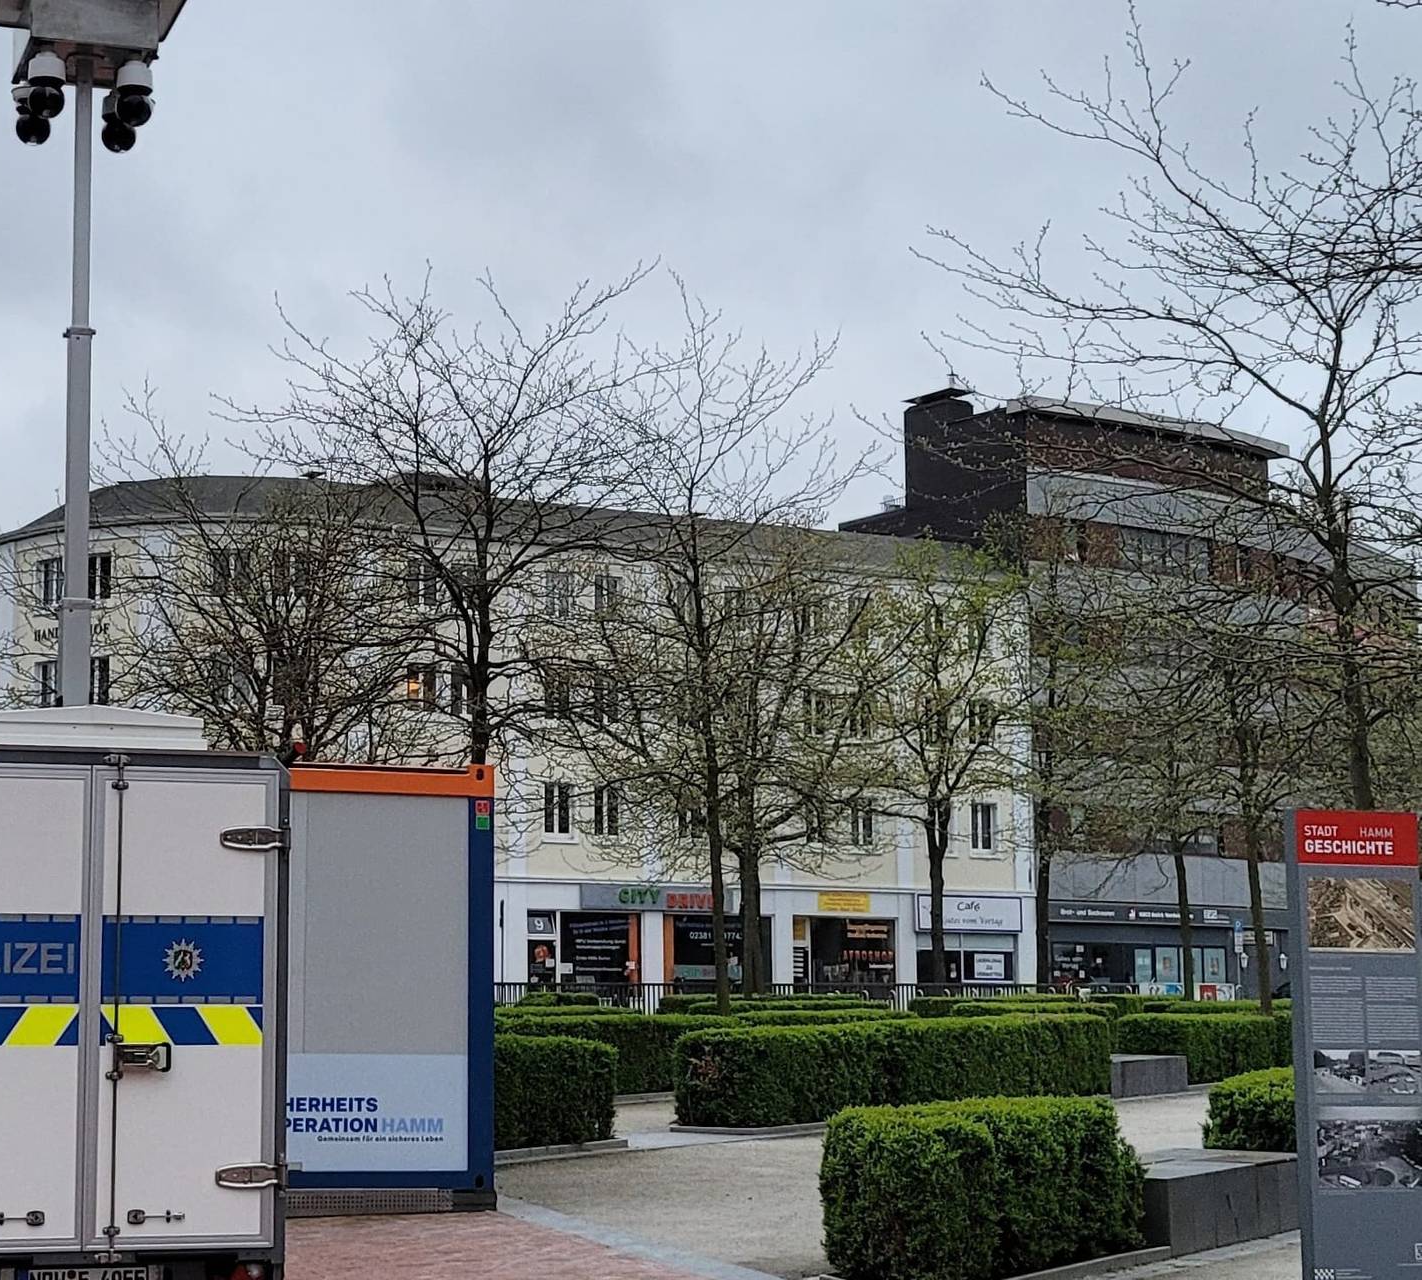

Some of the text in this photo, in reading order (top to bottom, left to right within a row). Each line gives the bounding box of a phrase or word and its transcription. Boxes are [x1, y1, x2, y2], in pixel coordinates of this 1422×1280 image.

[1304, 825, 1394, 838] STADT HAMM
[1304, 839, 1394, 855] GESCHICHTE
[619, 887, 659, 904] CITY
[534, 919, 544, 931] 9
[689, 932, 712, 940] 02381
[285, 1097, 378, 1113] HERHEITS
[382, 1118, 444, 1133] HAMM
